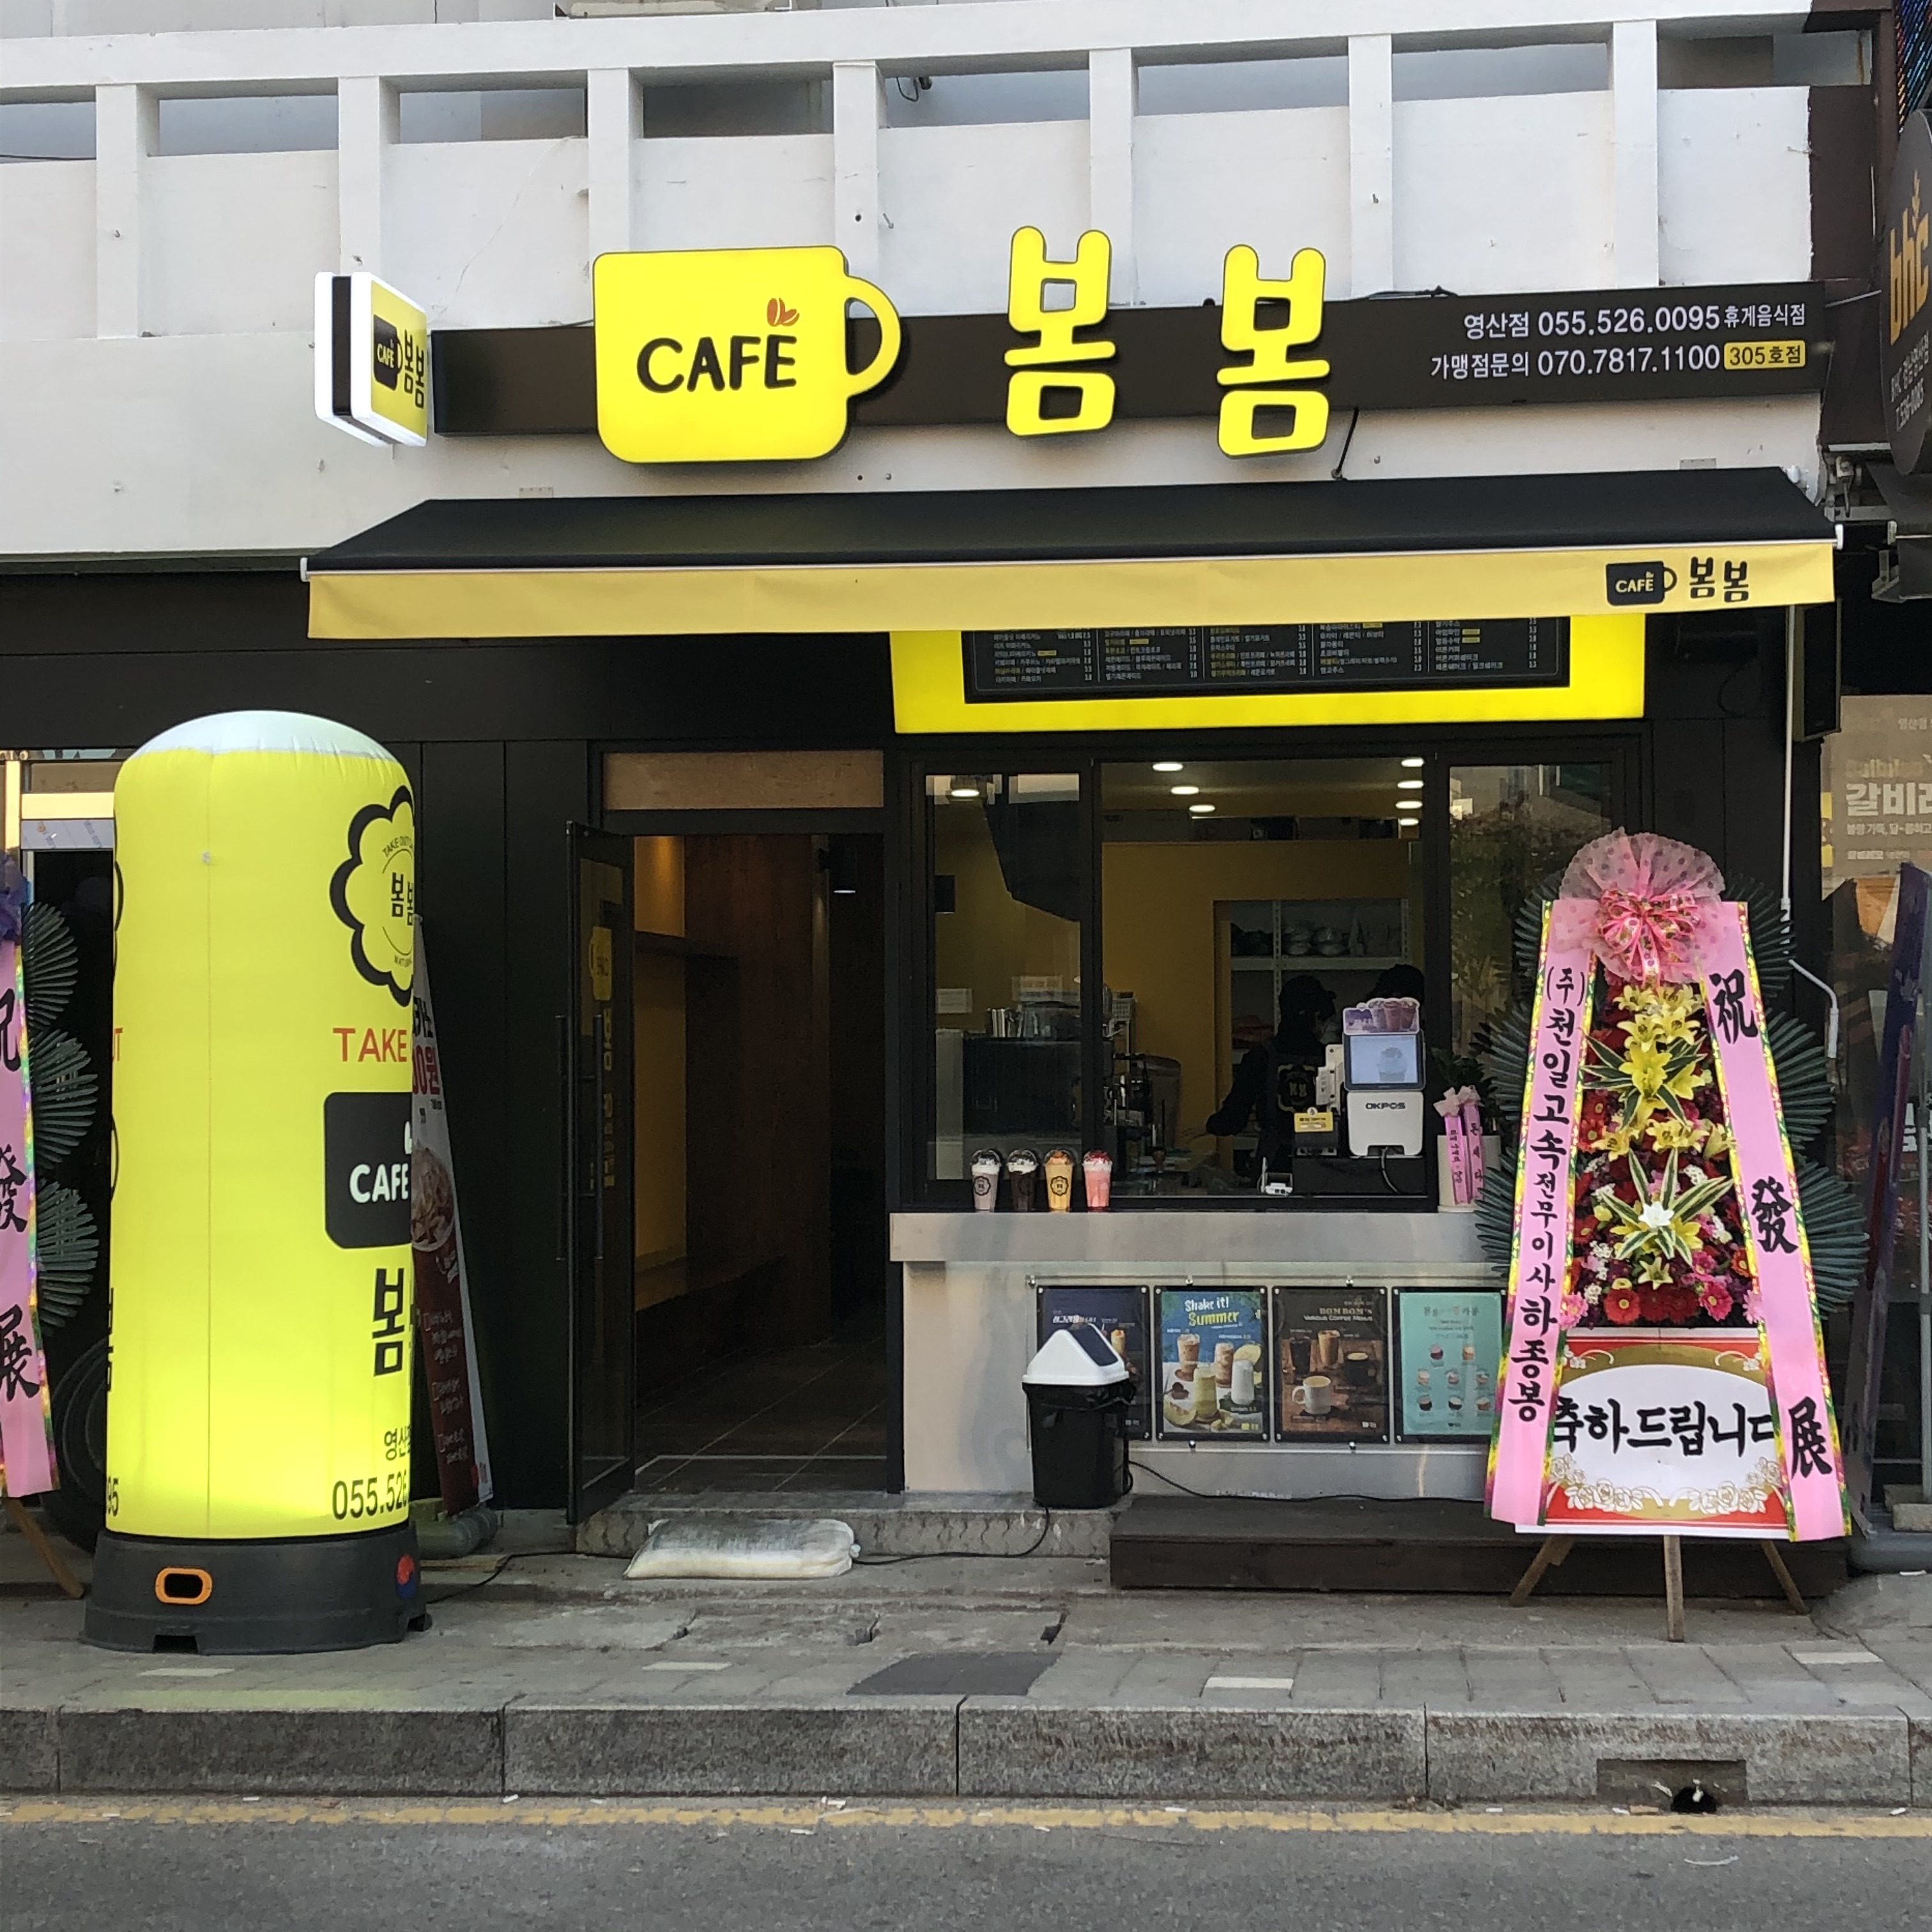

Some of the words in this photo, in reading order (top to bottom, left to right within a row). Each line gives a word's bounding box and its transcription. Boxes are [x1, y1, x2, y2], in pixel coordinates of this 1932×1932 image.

[1464, 311, 1529, 339] 영산점
[1538, 305, 1720, 336] 055.526.0095
[1724, 303, 1805, 328] 휴게음식점
[378, 343, 394, 369] CAFE
[1004, 226, 1330, 459] 봄봄
[404, 329, 424, 409] 봄봄
[637, 334, 797, 394] CAFE
[1431, 351, 1529, 379] 가맹점문의
[1538, 344, 1720, 376] 070.7817.1100
[1615, 579, 1654, 593] CAFE
[1689, 556, 1749, 602] 봄봄
[332, 1027, 408, 1062] TAKE
[349, 1163, 409, 1204] CAFE
[1184, 1299, 1214, 1312] Shake
[1188, 1311, 1239, 1327] Summer
